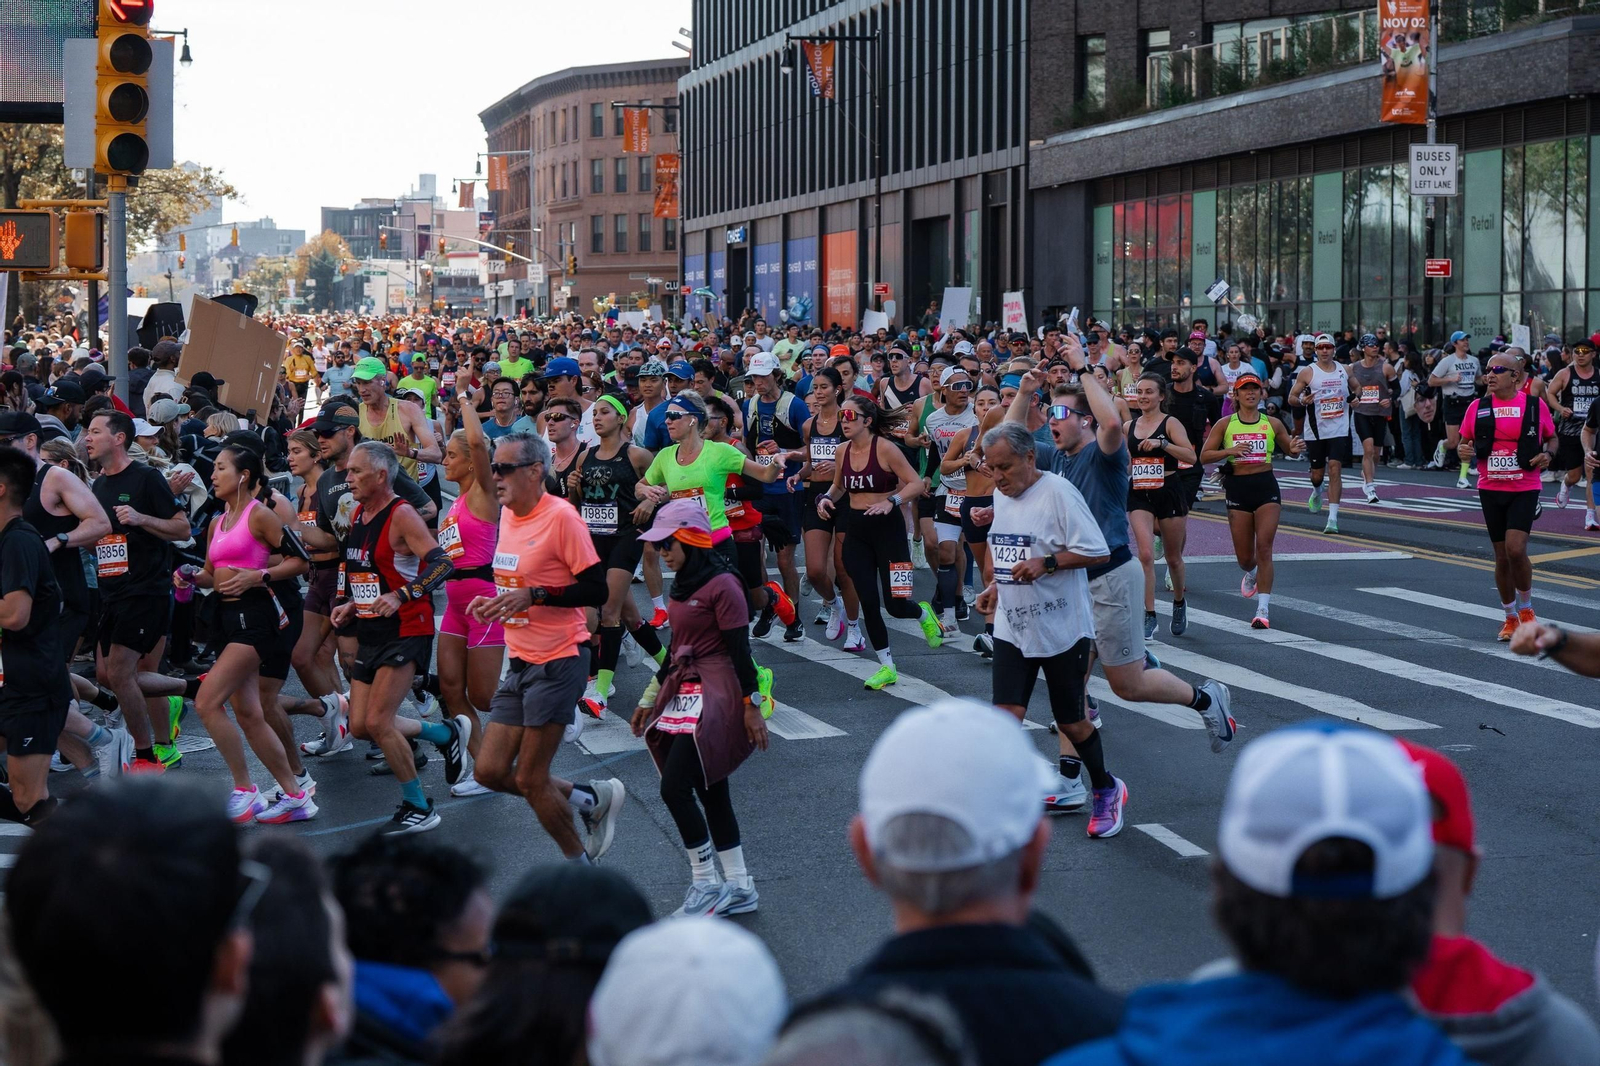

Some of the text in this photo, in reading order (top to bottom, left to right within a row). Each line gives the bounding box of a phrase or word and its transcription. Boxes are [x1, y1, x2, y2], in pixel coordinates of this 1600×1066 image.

[1383, 18, 1426, 28] NOV 02
[1416, 152, 1451, 161] BUSES
[1419, 166, 1447, 176] ONLY
[1415, 180, 1452, 189] LEFT LANE
[1470, 214, 1494, 231] Retail
[726, 229, 741, 244] CHASE
[1318, 229, 1337, 245] Retail
[1196, 242, 1212, 256] Retail
[1097, 252, 1110, 266] Retail
[1469, 316, 1486, 330] good
[1474, 326, 1493, 337] space
[1322, 402, 1343, 410] 25728
[1498, 407, 1514, 416] PAUL
[813, 445, 836, 455] 18162
[1489, 458, 1518, 467] 13033
[1133, 465, 1162, 476] 20436
[584, 508, 615, 520] 19856
[98, 545, 125, 559] 25856
[994, 547, 1027, 562] 14234
